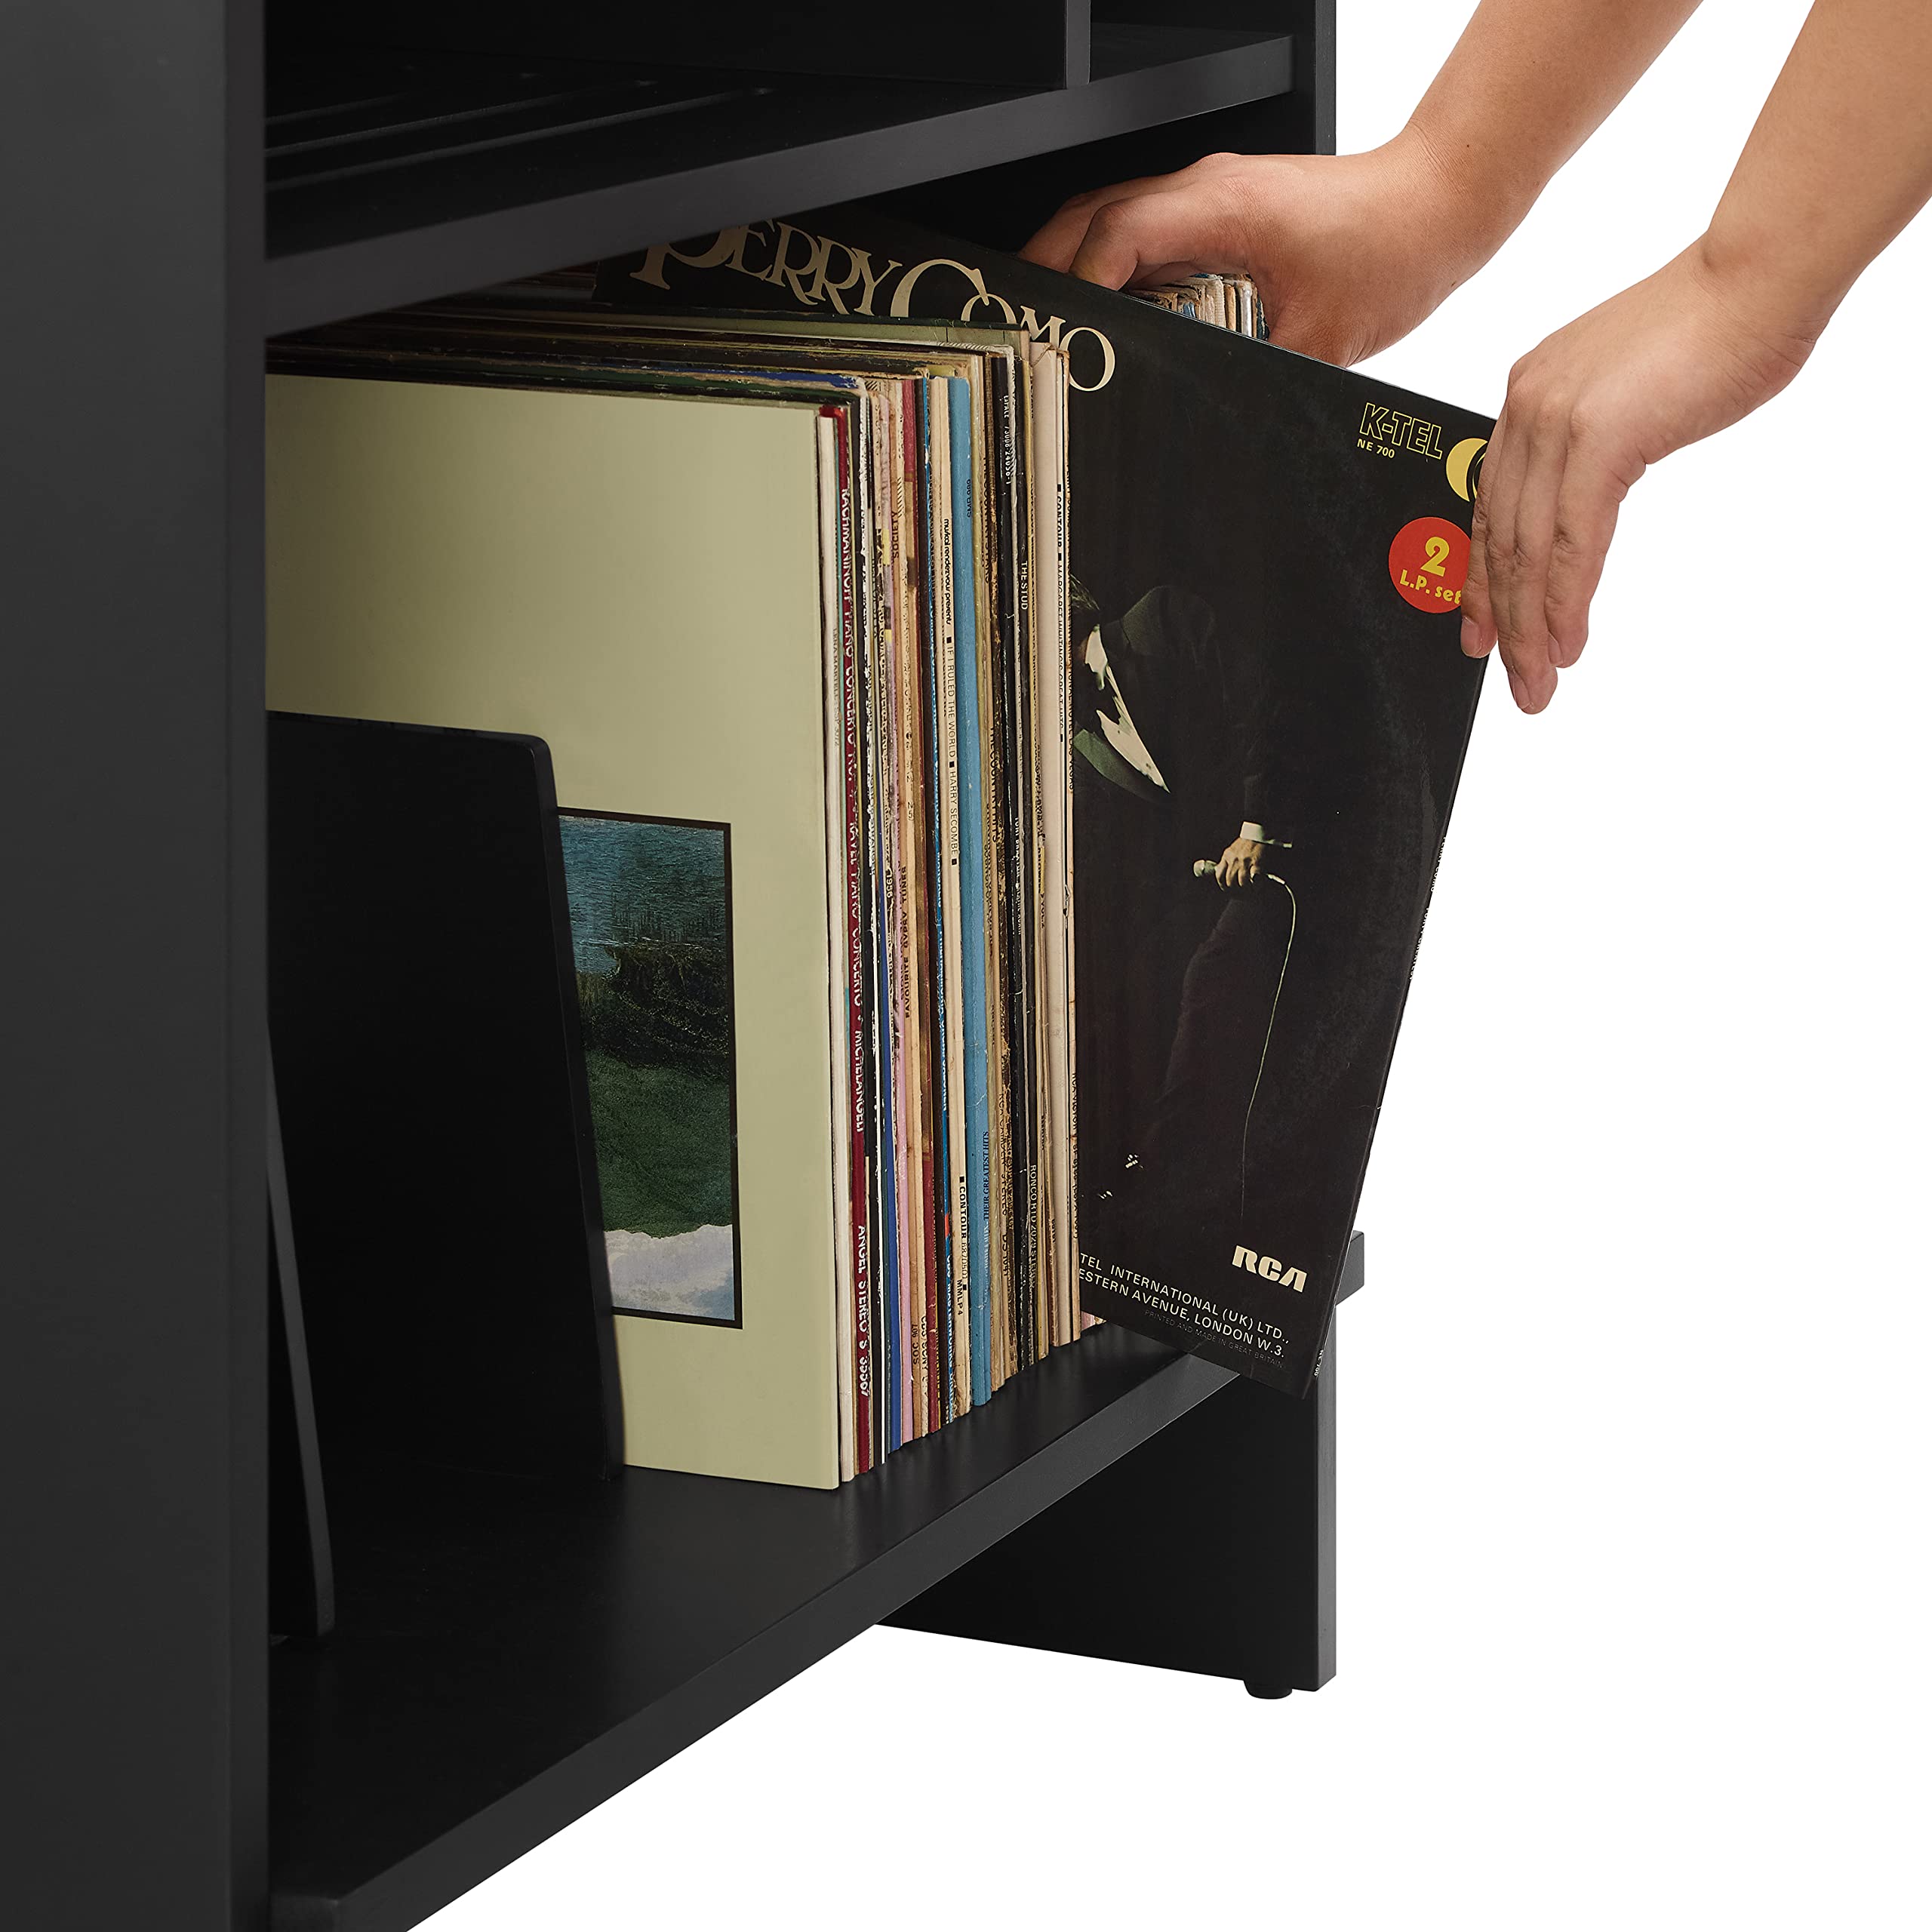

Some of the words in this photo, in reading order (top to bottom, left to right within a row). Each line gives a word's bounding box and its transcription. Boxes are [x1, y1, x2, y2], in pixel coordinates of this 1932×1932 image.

[1357, 438, 1374, 451] NE
[1377, 445, 1395, 459] 700
[1359, 402, 1444, 460] K-TEL
[891, 510, 900, 558] SOCIETY
[1420, 536, 1450, 577] 2
[1399, 569, 1430, 594] L.P.
[858, 1225, 867, 1274] ANGEL
[1232, 1244, 1308, 1294] RCA
[1110, 1264, 1220, 1316] INTERNATIONAL
[1222, 1308, 1254, 1331] (UK)
[1256, 1322, 1291, 1345] LTD.,
[1131, 1288, 1191, 1321] AVENUE,
[1195, 1313, 1254, 1345] LONDON
[1257, 1337, 1285, 1358] W.3.
[1144, 1309, 1175, 1327] PRINTED
[1177, 1321, 1194, 1334] AND
[1195, 1327, 1217, 1343] MADE
[1219, 1337, 1226, 1347] IN
[1228, 1341, 1253, 1356] GREAT
